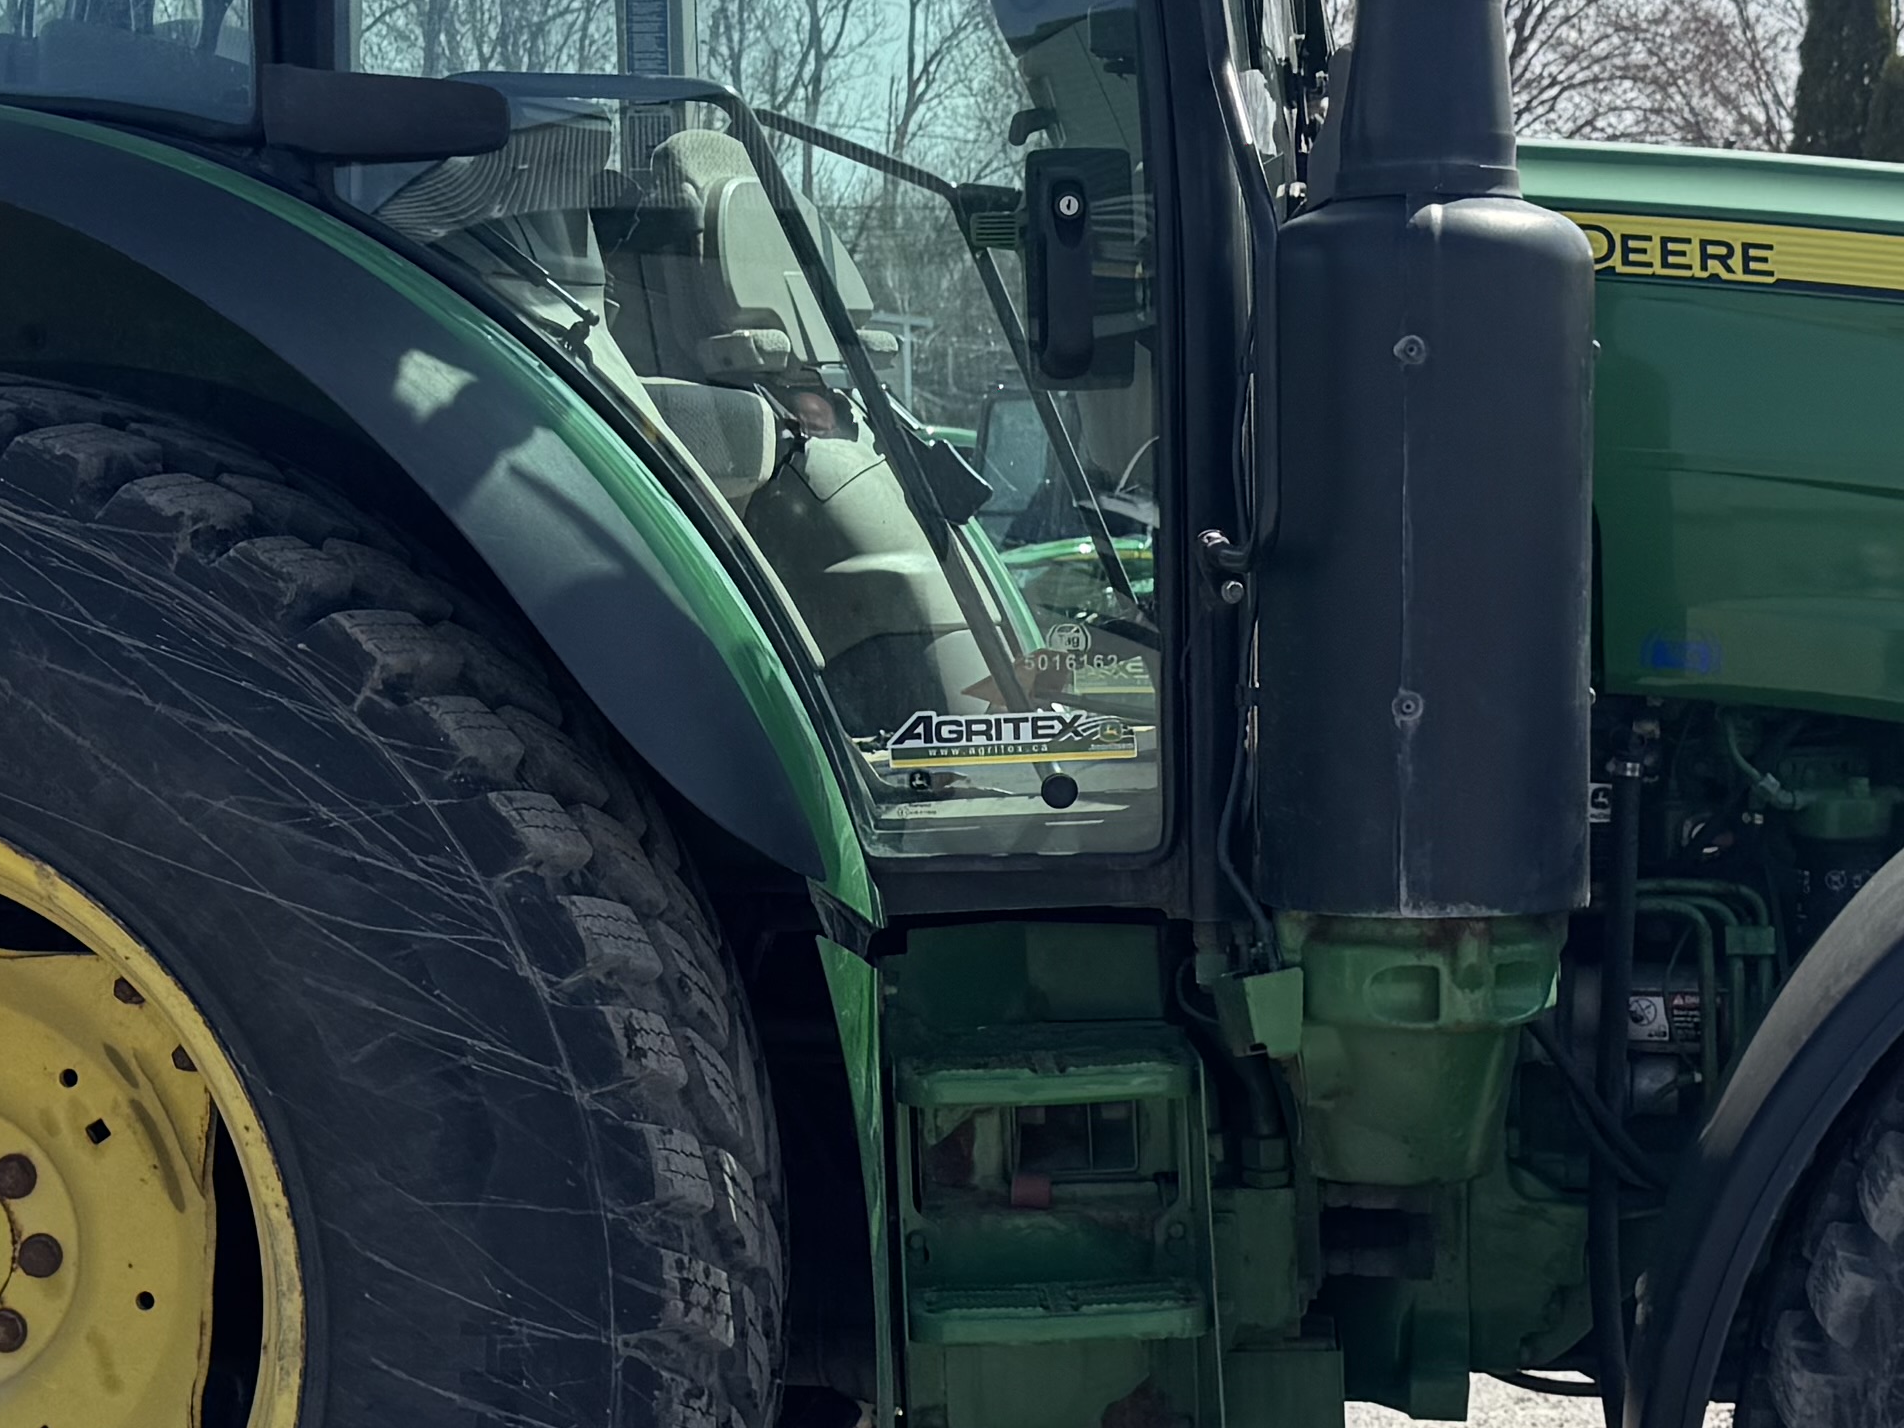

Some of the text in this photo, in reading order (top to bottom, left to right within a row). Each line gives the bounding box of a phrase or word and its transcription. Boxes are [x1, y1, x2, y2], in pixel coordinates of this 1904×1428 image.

[1577, 223, 1775, 277] DEERE
[1024, 654, 1118, 671] 5016162
[892, 713, 1084, 745] AGRITEX
